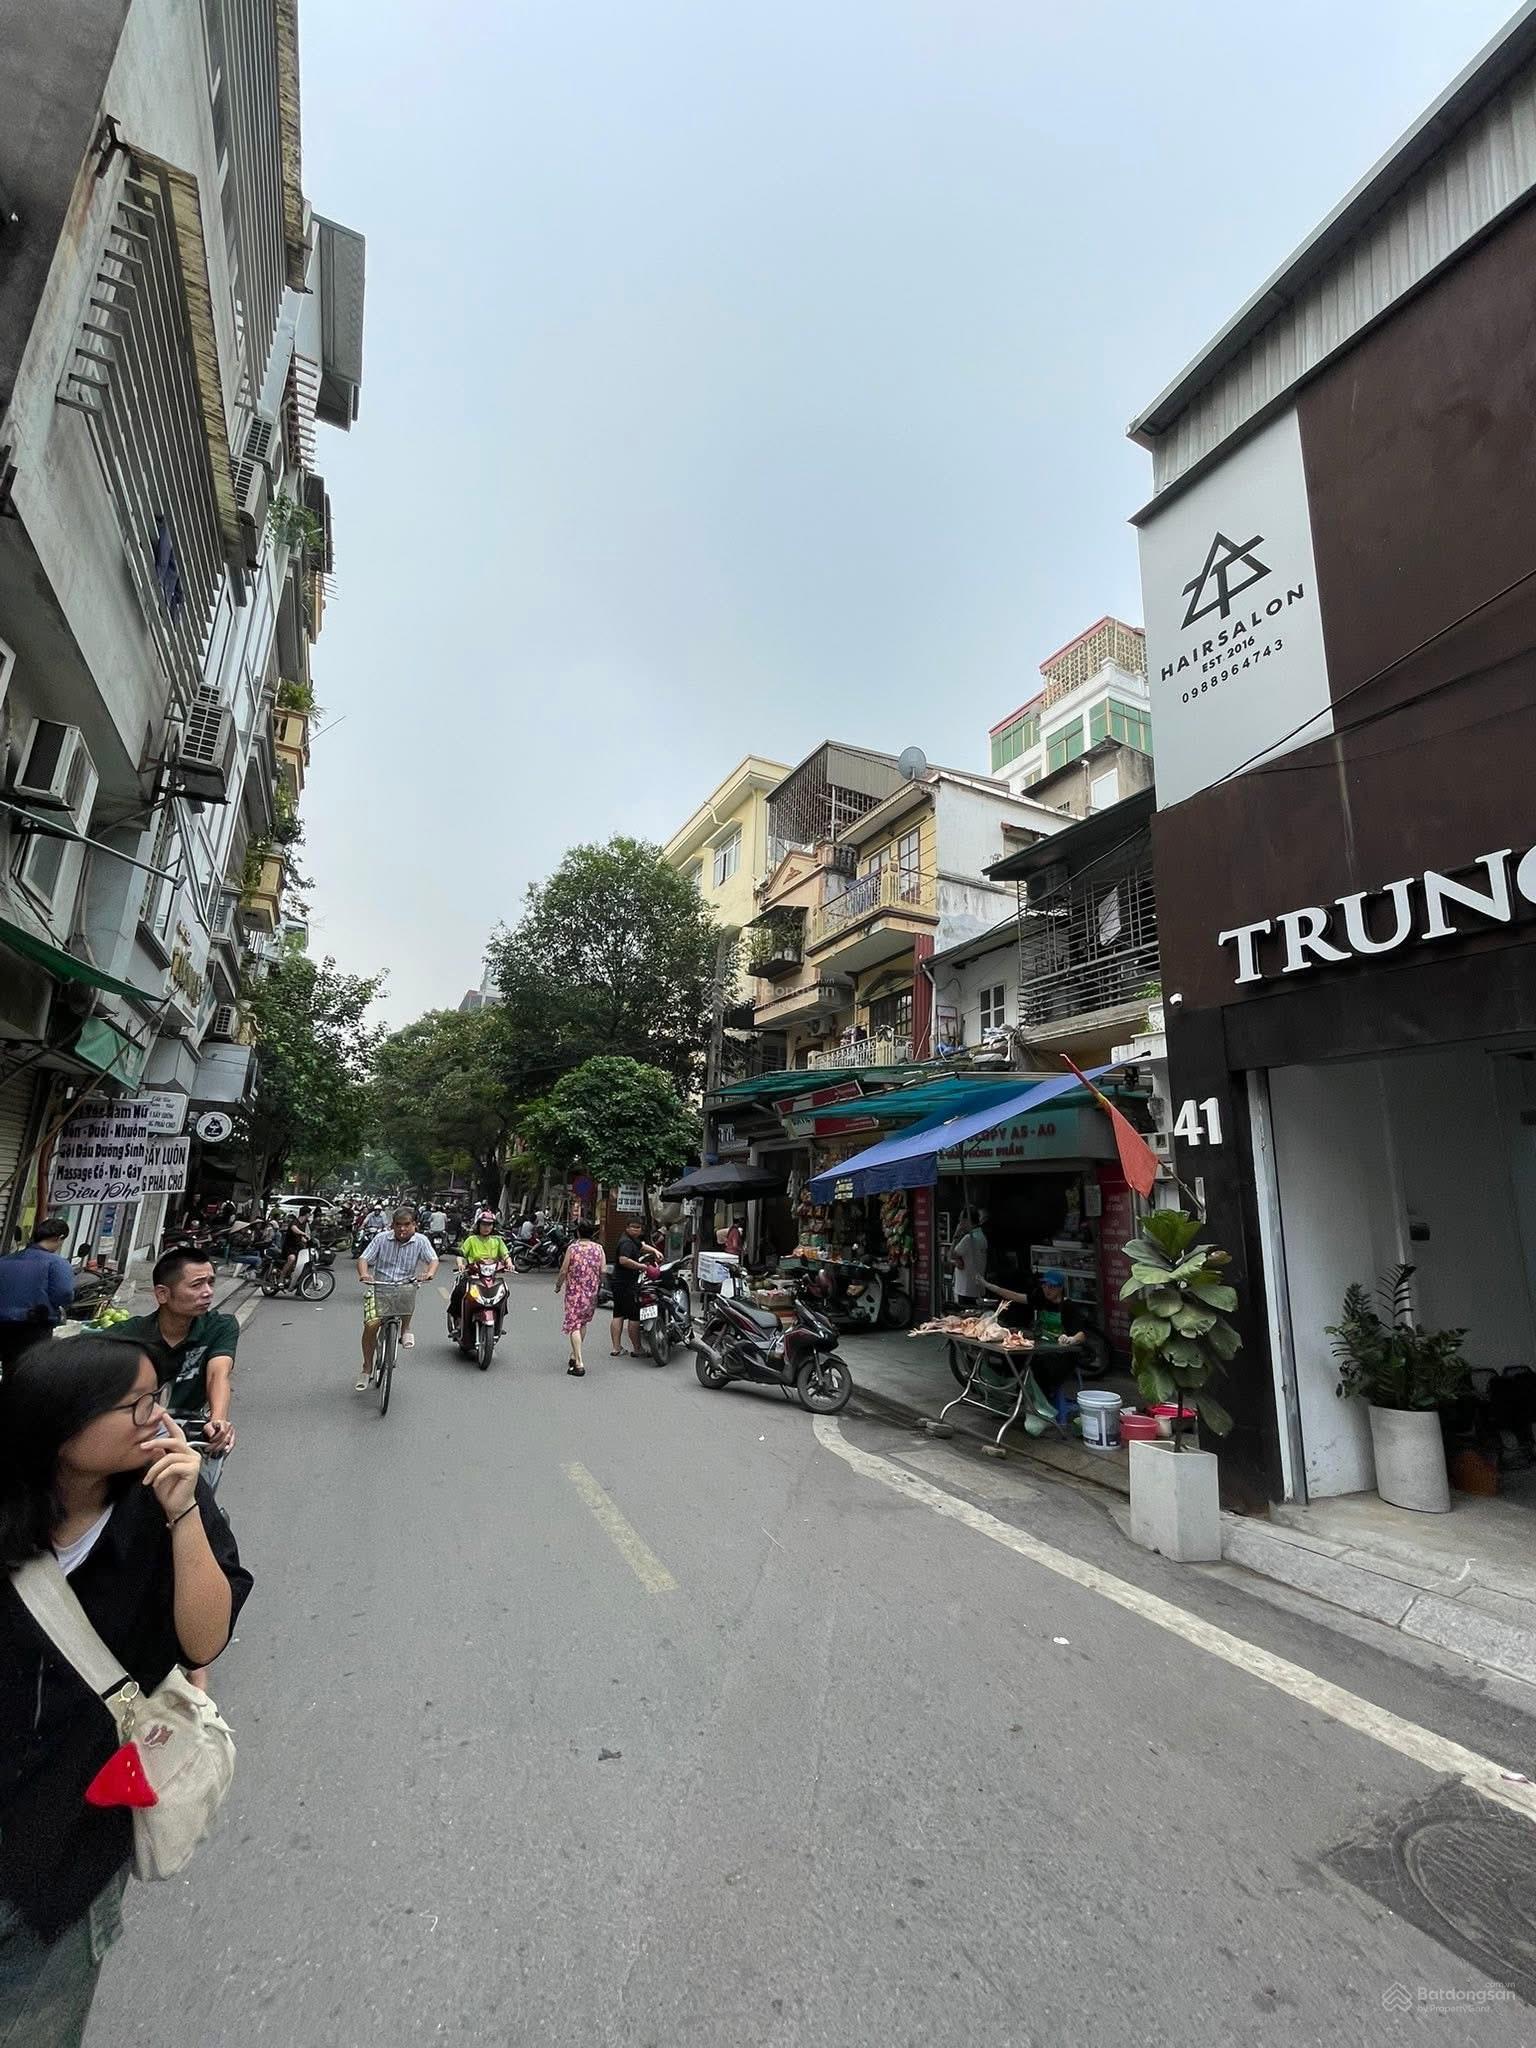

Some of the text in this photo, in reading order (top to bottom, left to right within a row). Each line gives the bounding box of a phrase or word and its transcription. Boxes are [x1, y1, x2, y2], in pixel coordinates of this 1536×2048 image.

[1161, 583, 1304, 681] HAIRSALON
[1227, 636, 1255, 658] 2016
[1182, 639, 1283, 703] 0988964743
[1174, 1097, 1222, 1146] 41
[124, 1142, 145, 1157] Sinh
[162, 1143, 186, 1165] LUÔN
[109, 1164, 122, 1179] Vai
